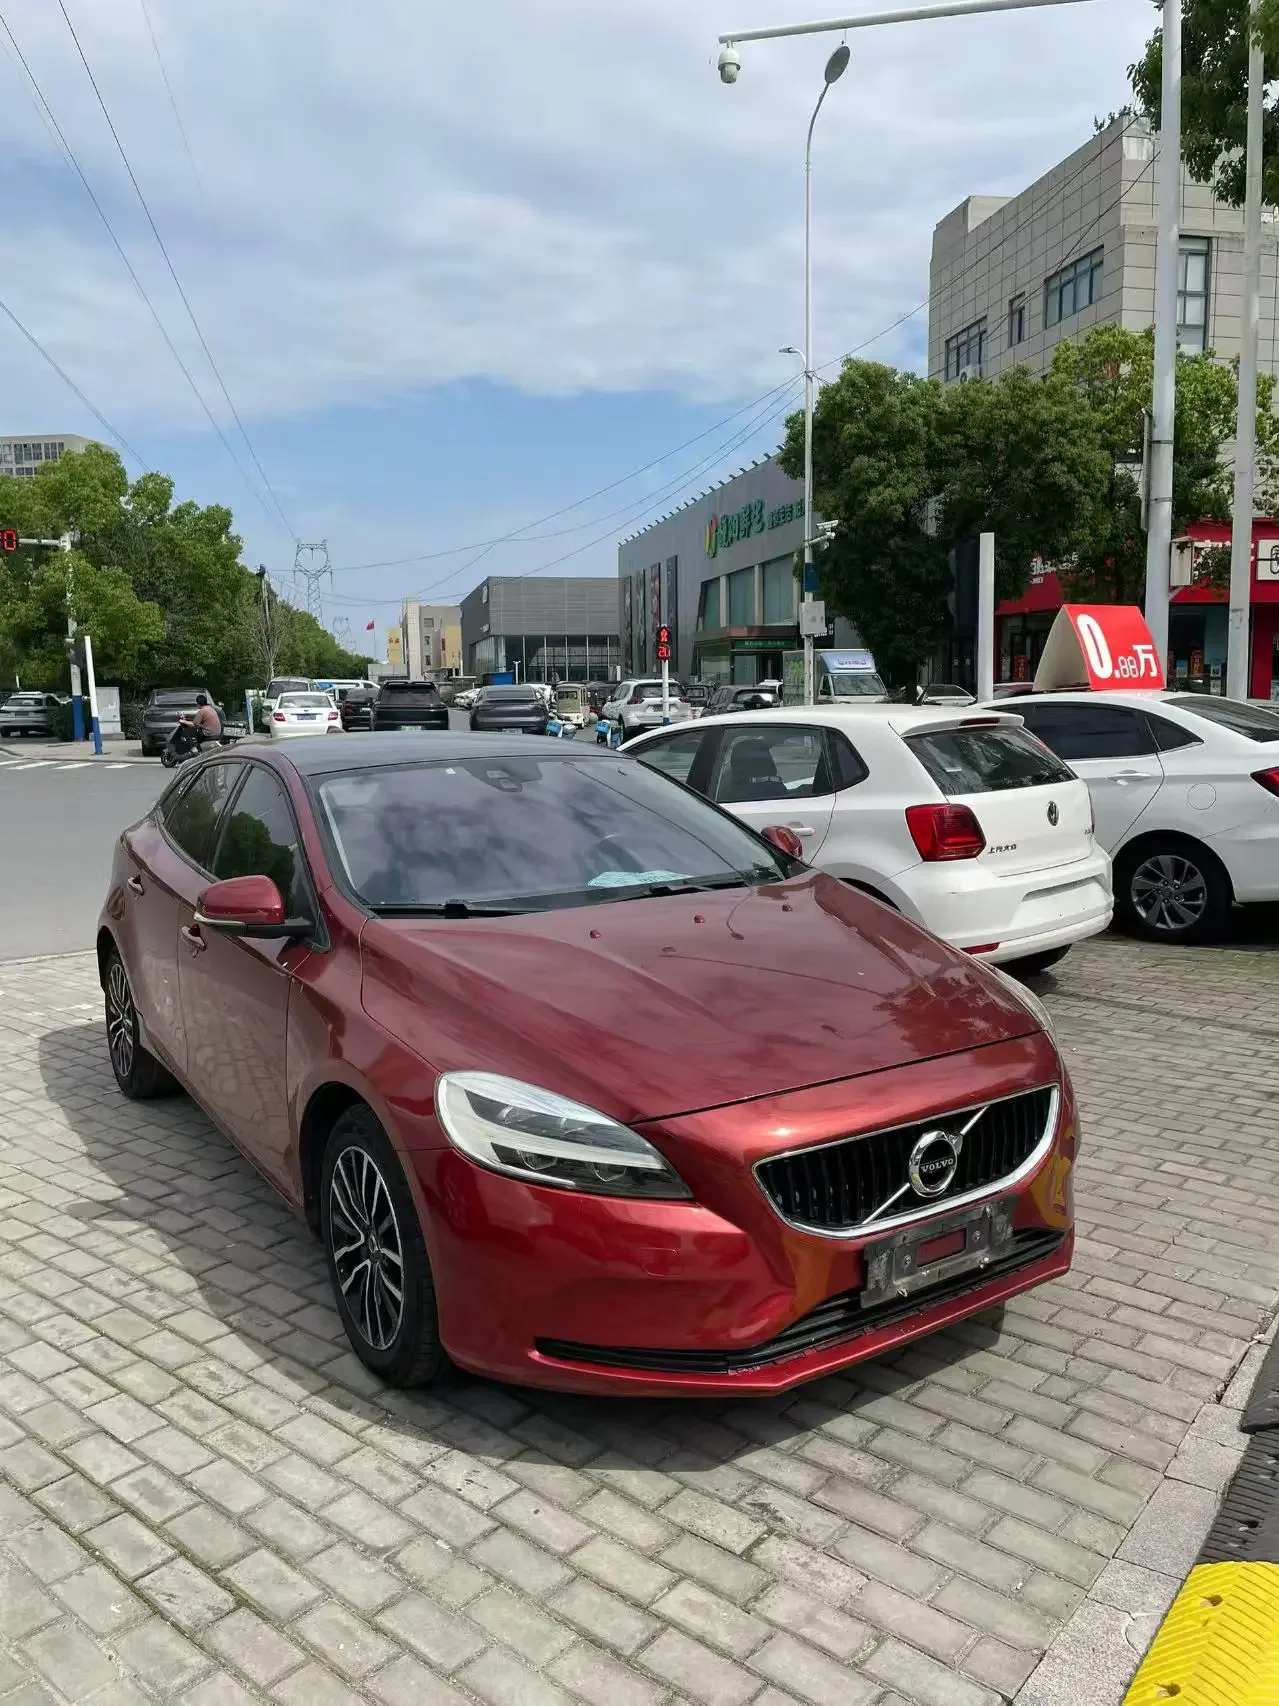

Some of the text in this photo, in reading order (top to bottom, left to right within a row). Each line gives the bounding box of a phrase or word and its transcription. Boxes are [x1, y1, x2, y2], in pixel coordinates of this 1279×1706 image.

[0, 530, 16, 550] 0
[1077, 613, 1158, 678] 0.88万
[921, 1158, 954, 1172] VOLVO
